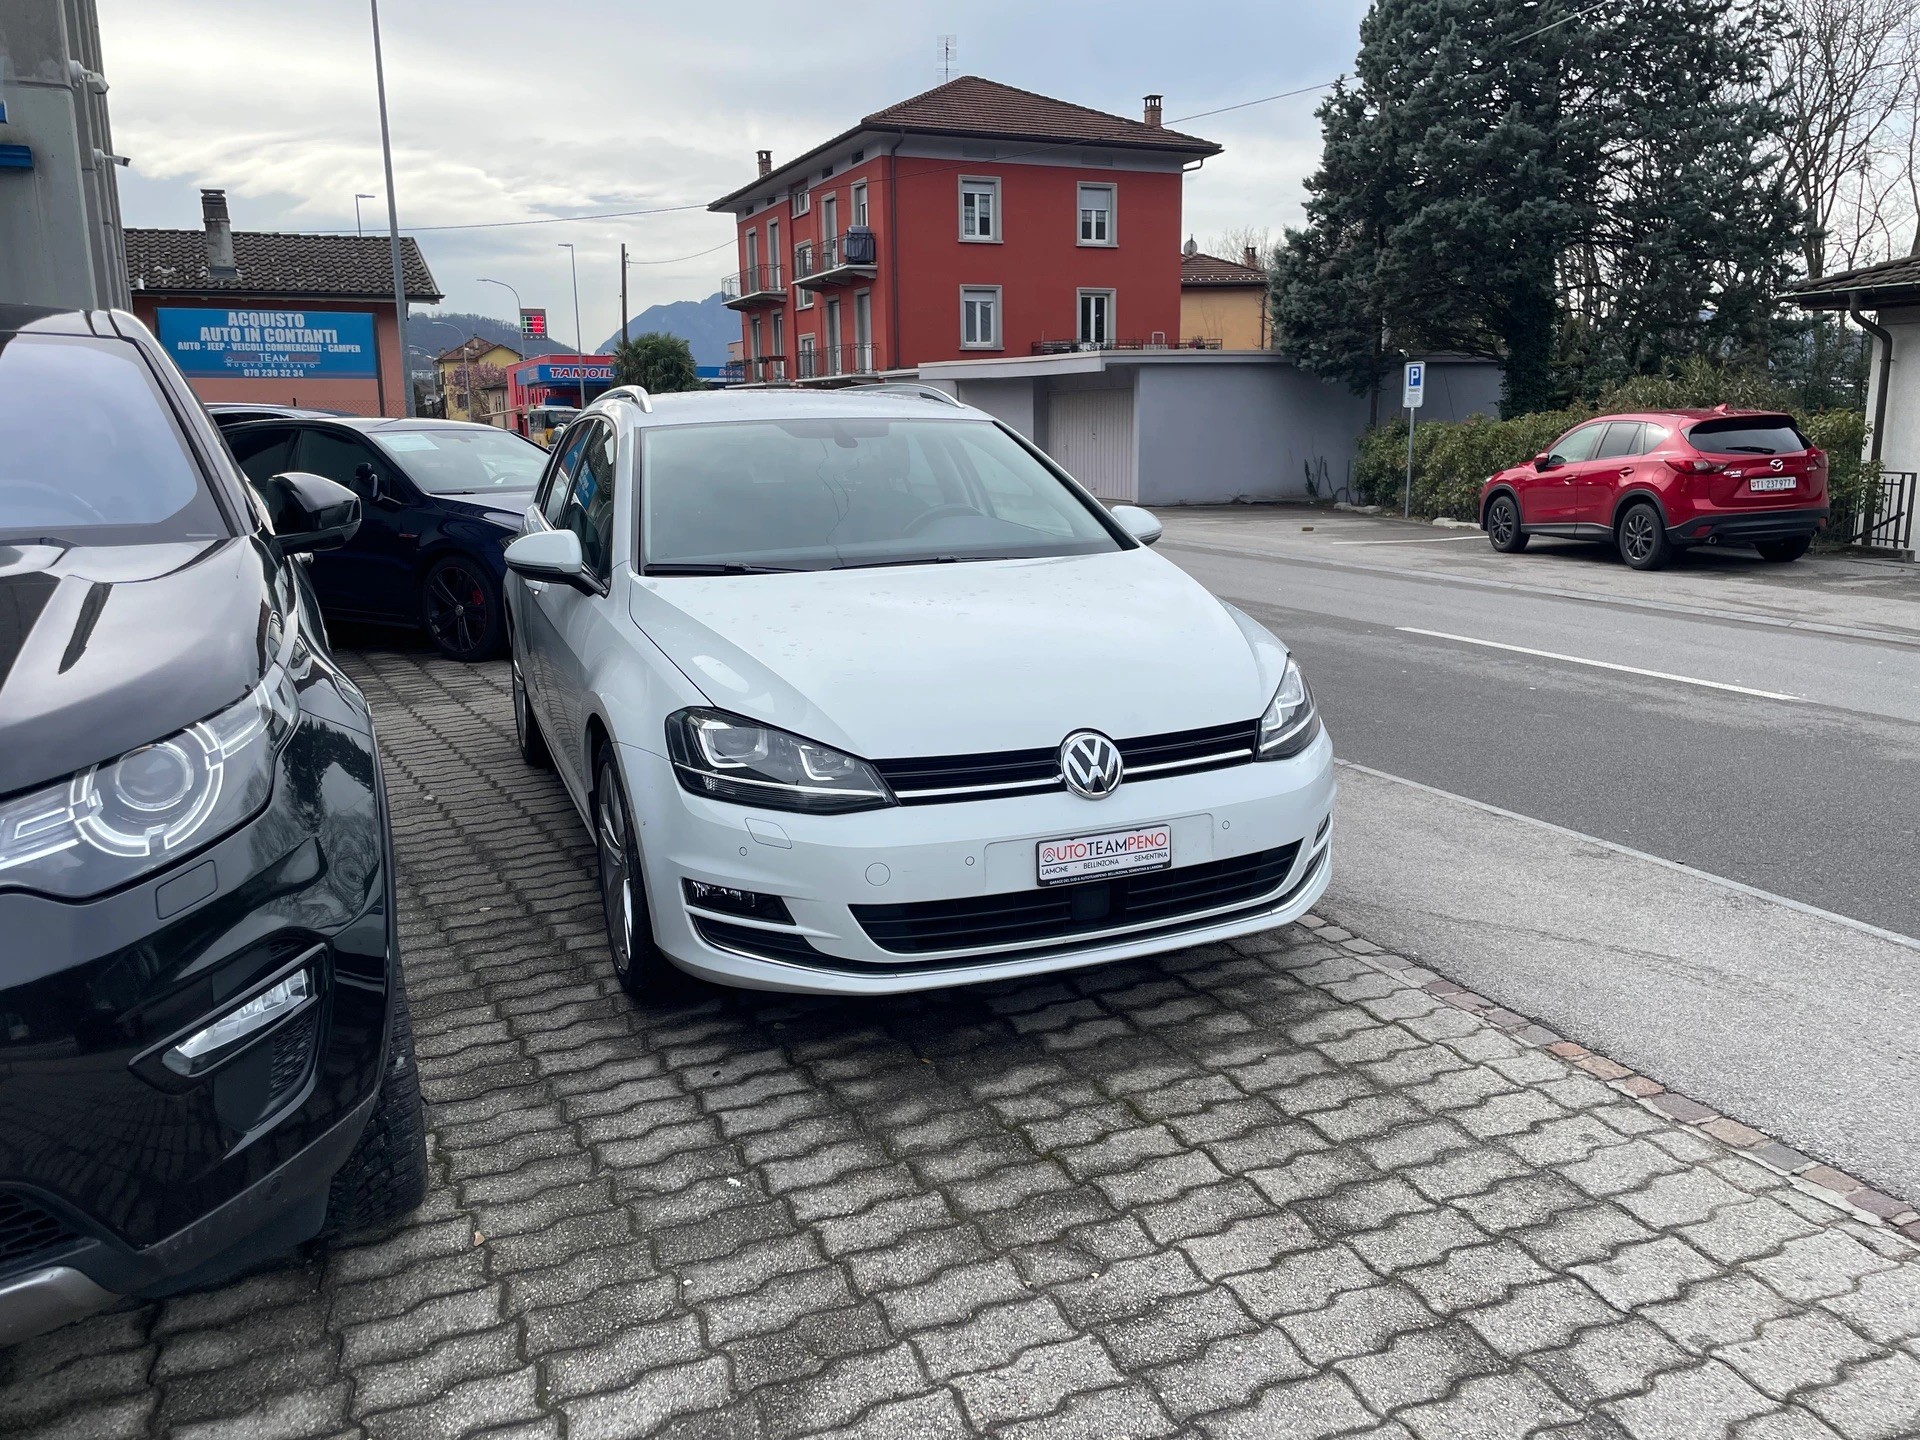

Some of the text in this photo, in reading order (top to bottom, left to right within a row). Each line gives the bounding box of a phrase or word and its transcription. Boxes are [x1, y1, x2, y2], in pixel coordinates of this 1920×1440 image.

[227, 311, 305, 328] ACQUISTO
[200, 327, 338, 344] AUTO IN CONTANTI
[177, 341, 200, 350] AUTO
[207, 342, 225, 350] JEEP
[231, 342, 264, 351] VEICOLI
[265, 343, 322, 352] COMMERCIALI
[328, 344, 361, 353] CAMPER
[550, 367, 615, 379] TAMOIL
[1410, 367, 1420, 385] P
[1041, 851, 1168, 875] LAMONE BELLINZONA SEMENTINA
